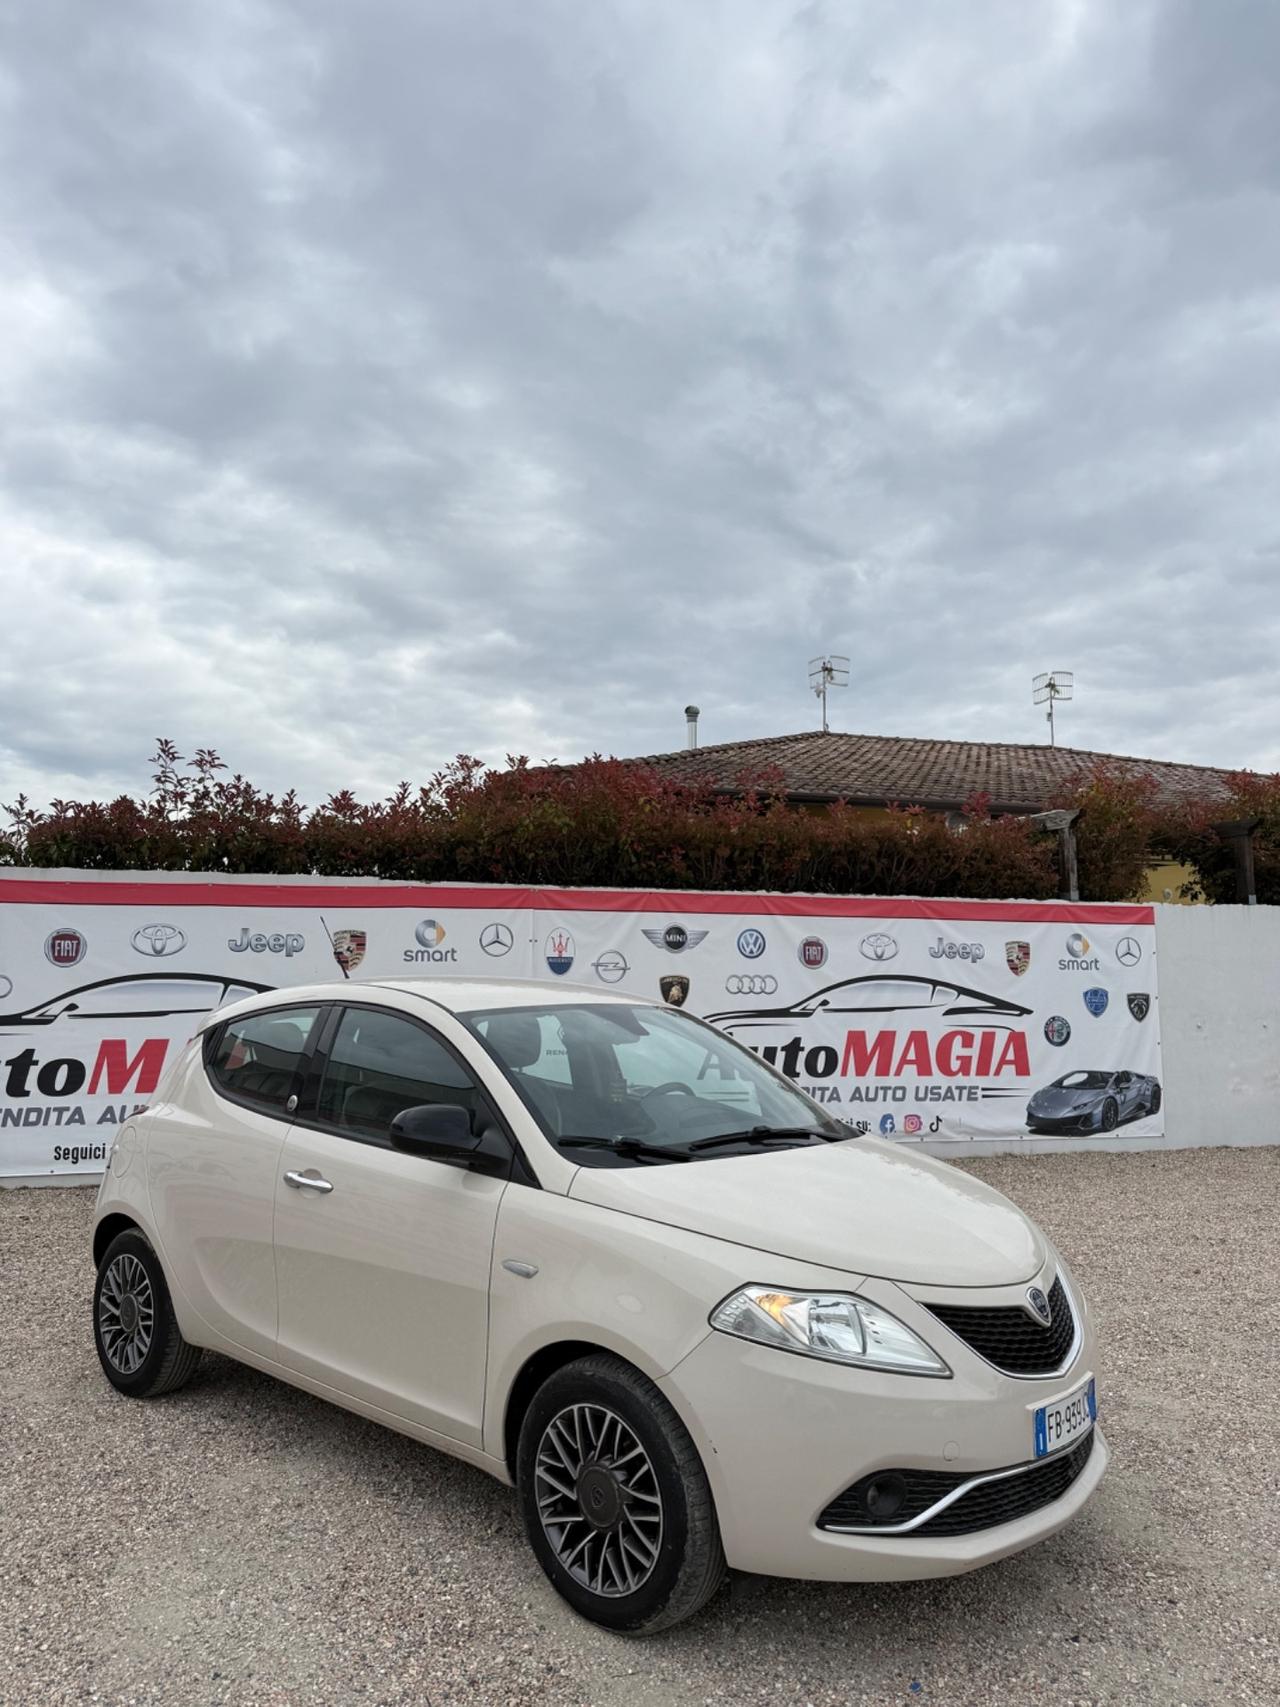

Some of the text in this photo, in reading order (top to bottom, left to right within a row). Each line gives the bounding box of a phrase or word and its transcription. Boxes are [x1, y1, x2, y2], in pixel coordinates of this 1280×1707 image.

[228, 928, 305, 957] Jeep
[665, 934, 687, 942] MINI
[54, 940, 79, 957] FIAT
[403, 949, 457, 962] smart
[805, 945, 822, 961] FIAT
[928, 937, 985, 963] Jeep
[1058, 958, 1100, 971] smart
[849, 1086, 907, 1102] AUTO
[914, 1085, 979, 1102] USATE
[0, 1106, 86, 1128] NDITA
[54, 1143, 106, 1164] Seguici
